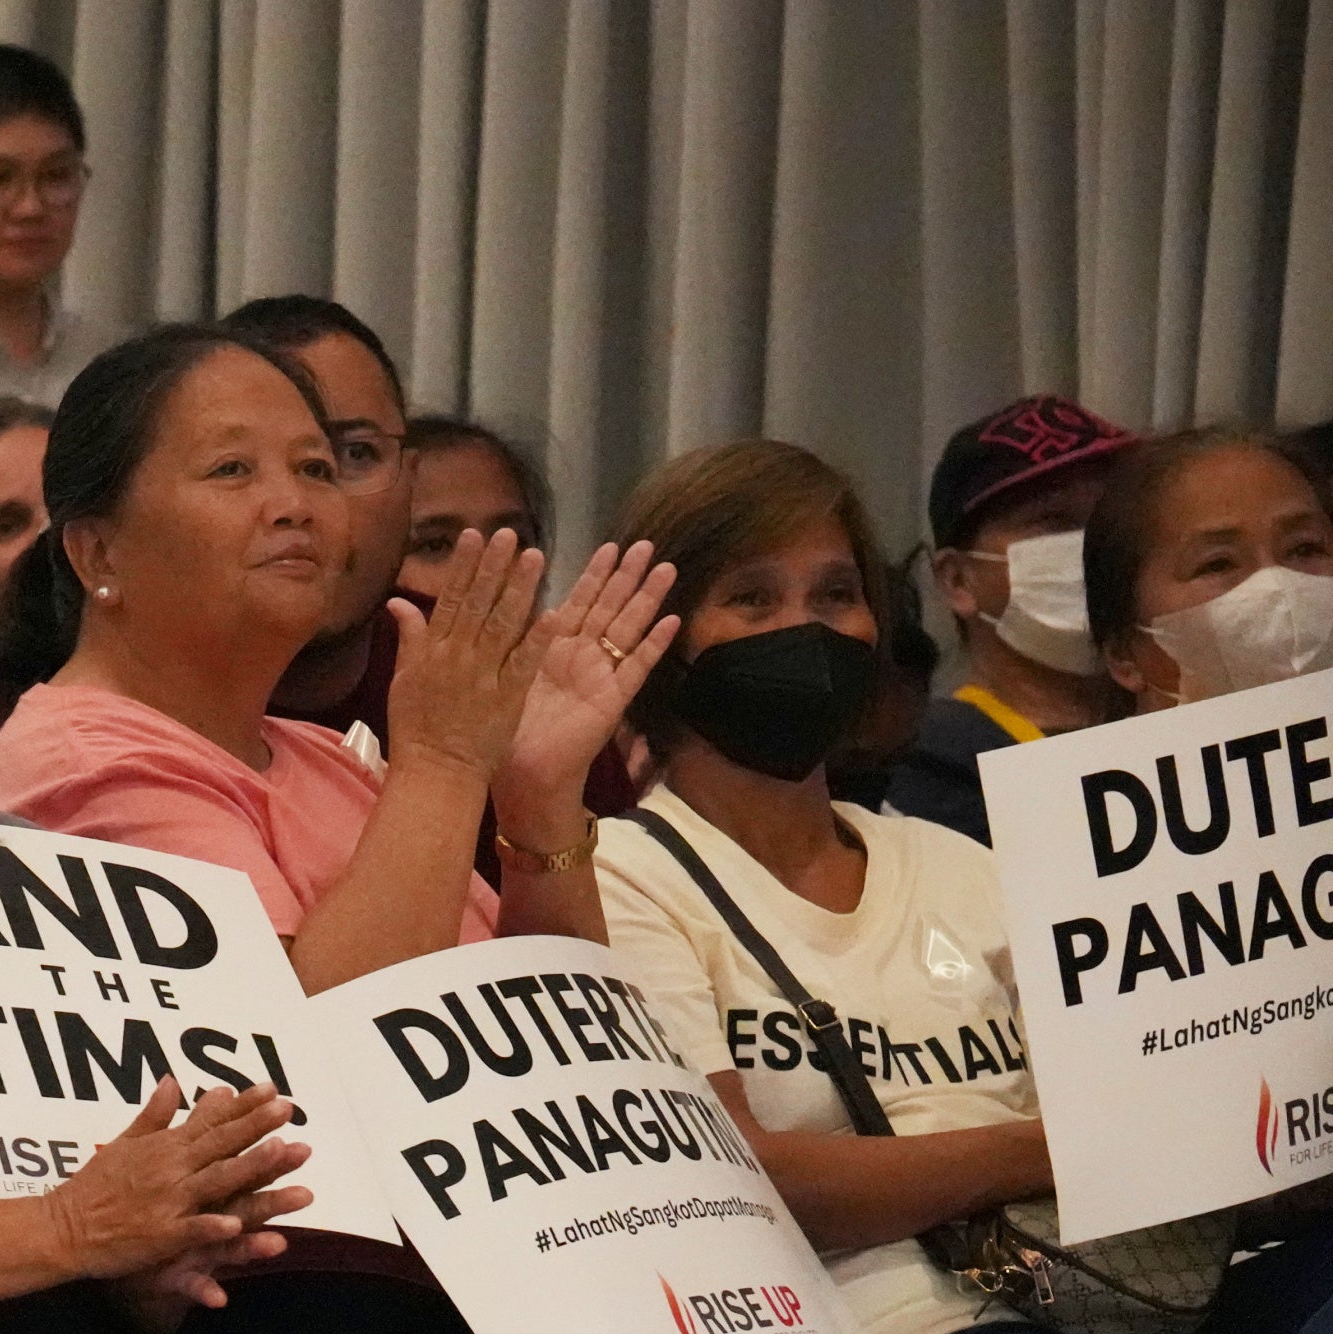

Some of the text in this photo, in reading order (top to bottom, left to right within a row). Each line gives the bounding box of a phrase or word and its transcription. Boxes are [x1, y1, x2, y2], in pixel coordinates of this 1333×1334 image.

[40, 963, 180, 1011] THE
[372, 972, 690, 1104] DUTERTE
[3, 1181, 38, 1194] LIFE
[760, 1285, 804, 1327] UP
